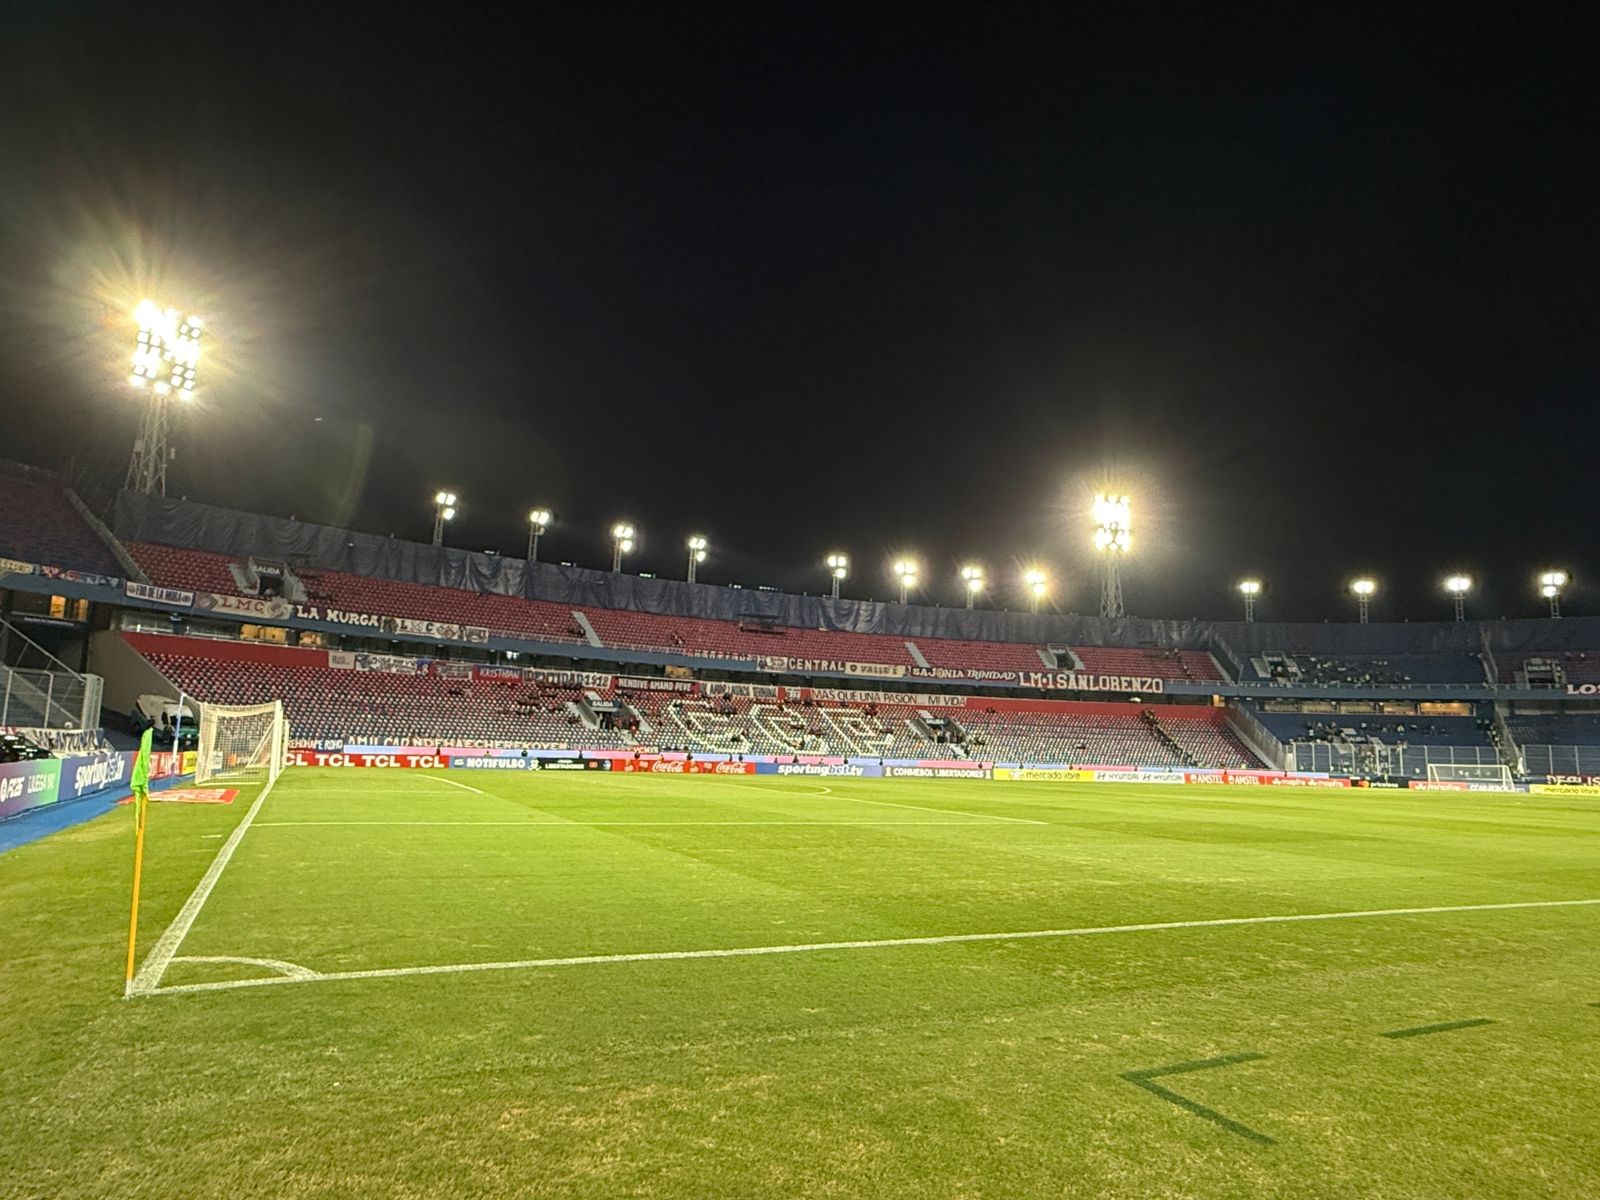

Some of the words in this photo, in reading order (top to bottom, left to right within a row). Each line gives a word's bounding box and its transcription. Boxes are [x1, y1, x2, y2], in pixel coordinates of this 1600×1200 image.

[296, 605, 320, 619] LA
[326, 609, 379, 627] MURGA
[788, 658, 845, 673] CENTRAL
[966, 669, 1016, 681] TRINIDAD
[837, 691, 858, 701] QUE
[859, 692, 881, 702] UNA
[928, 695, 940, 704] MI
[943, 696, 966, 706] VIDA
[284, 754, 308, 766] CL
[315, 754, 355, 767] TCL
[361, 755, 401, 768] TCL
[407, 756, 445, 768] TCL
[466, 758, 526, 769] NOTIFULBO
[893, 767, 934, 776] CONMEBOL
[935, 768, 984, 778] LIBERTADORES
[1025, 771, 1062, 780] mercado
[1197, 774, 1225, 784] AMSTEL
[1234, 775, 1260, 785] AMSTEL
